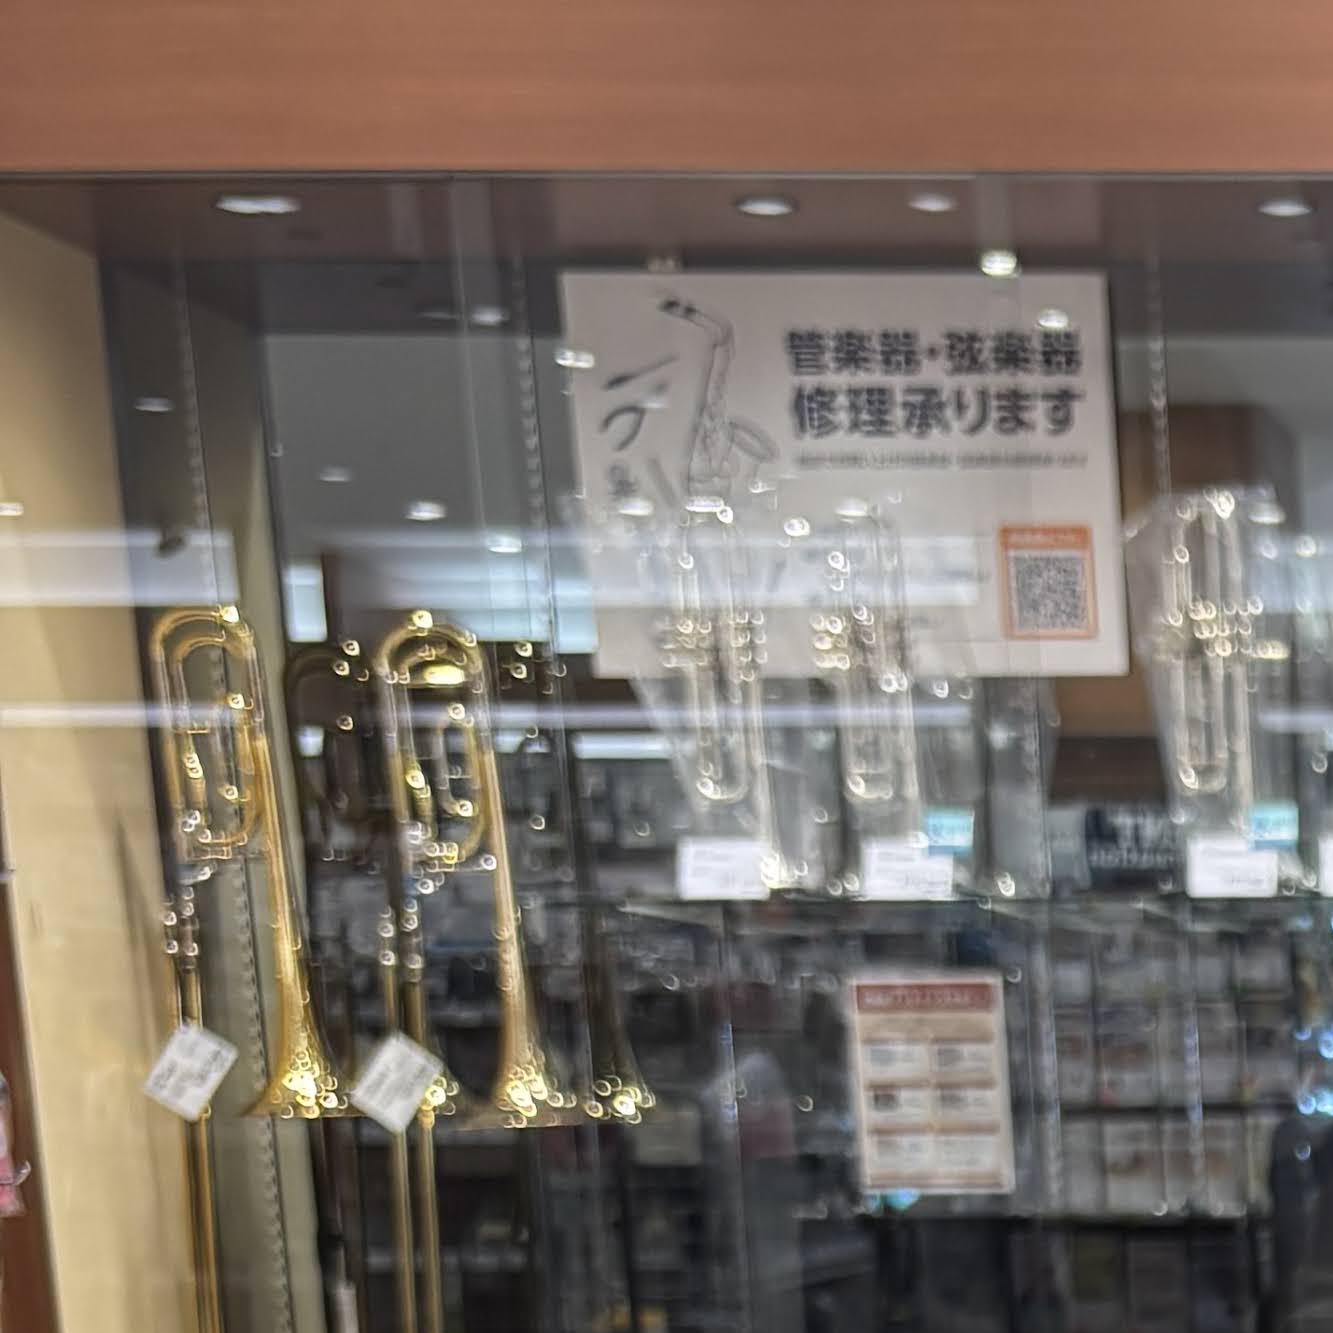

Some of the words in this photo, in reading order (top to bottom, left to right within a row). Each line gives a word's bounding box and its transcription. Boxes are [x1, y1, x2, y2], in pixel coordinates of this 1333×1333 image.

[787, 329, 1082, 375] 管楽器・弦楽器
[792, 385, 1085, 437] 修理承ります
